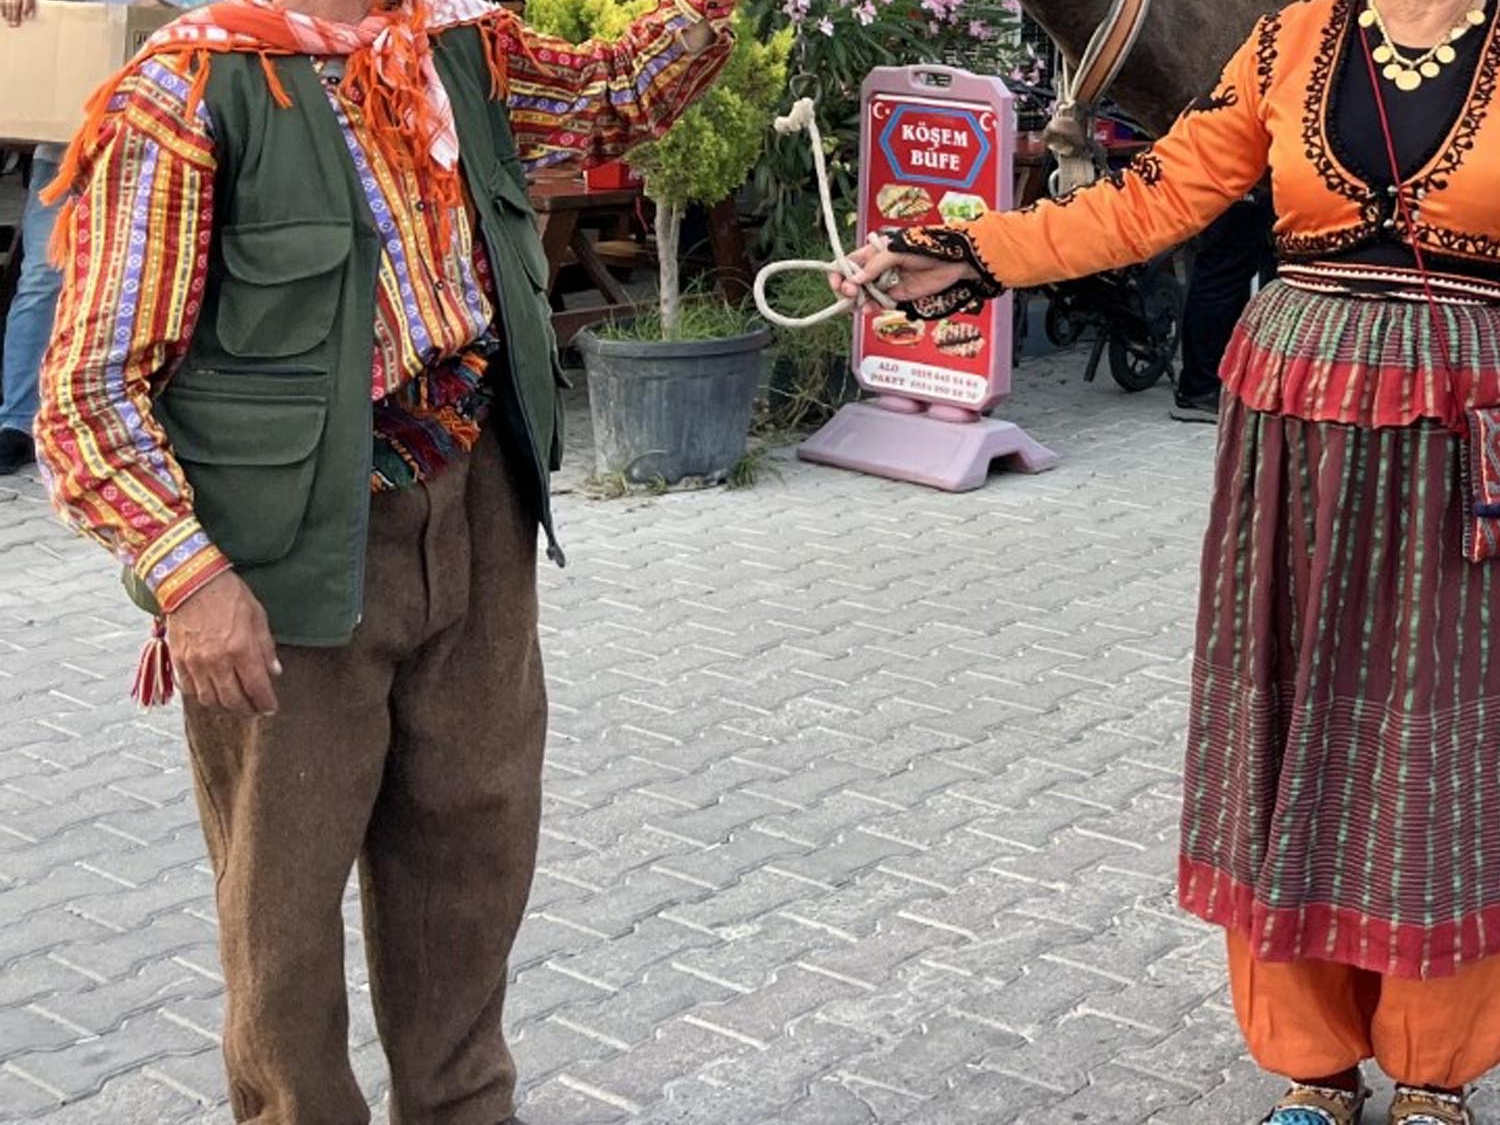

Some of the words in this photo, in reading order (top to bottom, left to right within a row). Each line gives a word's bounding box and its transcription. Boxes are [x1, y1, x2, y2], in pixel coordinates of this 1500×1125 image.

[902, 121, 968, 149] KÖŞEM
[910, 147, 960, 171] BÜFE
[878, 361, 900, 373] ALO
